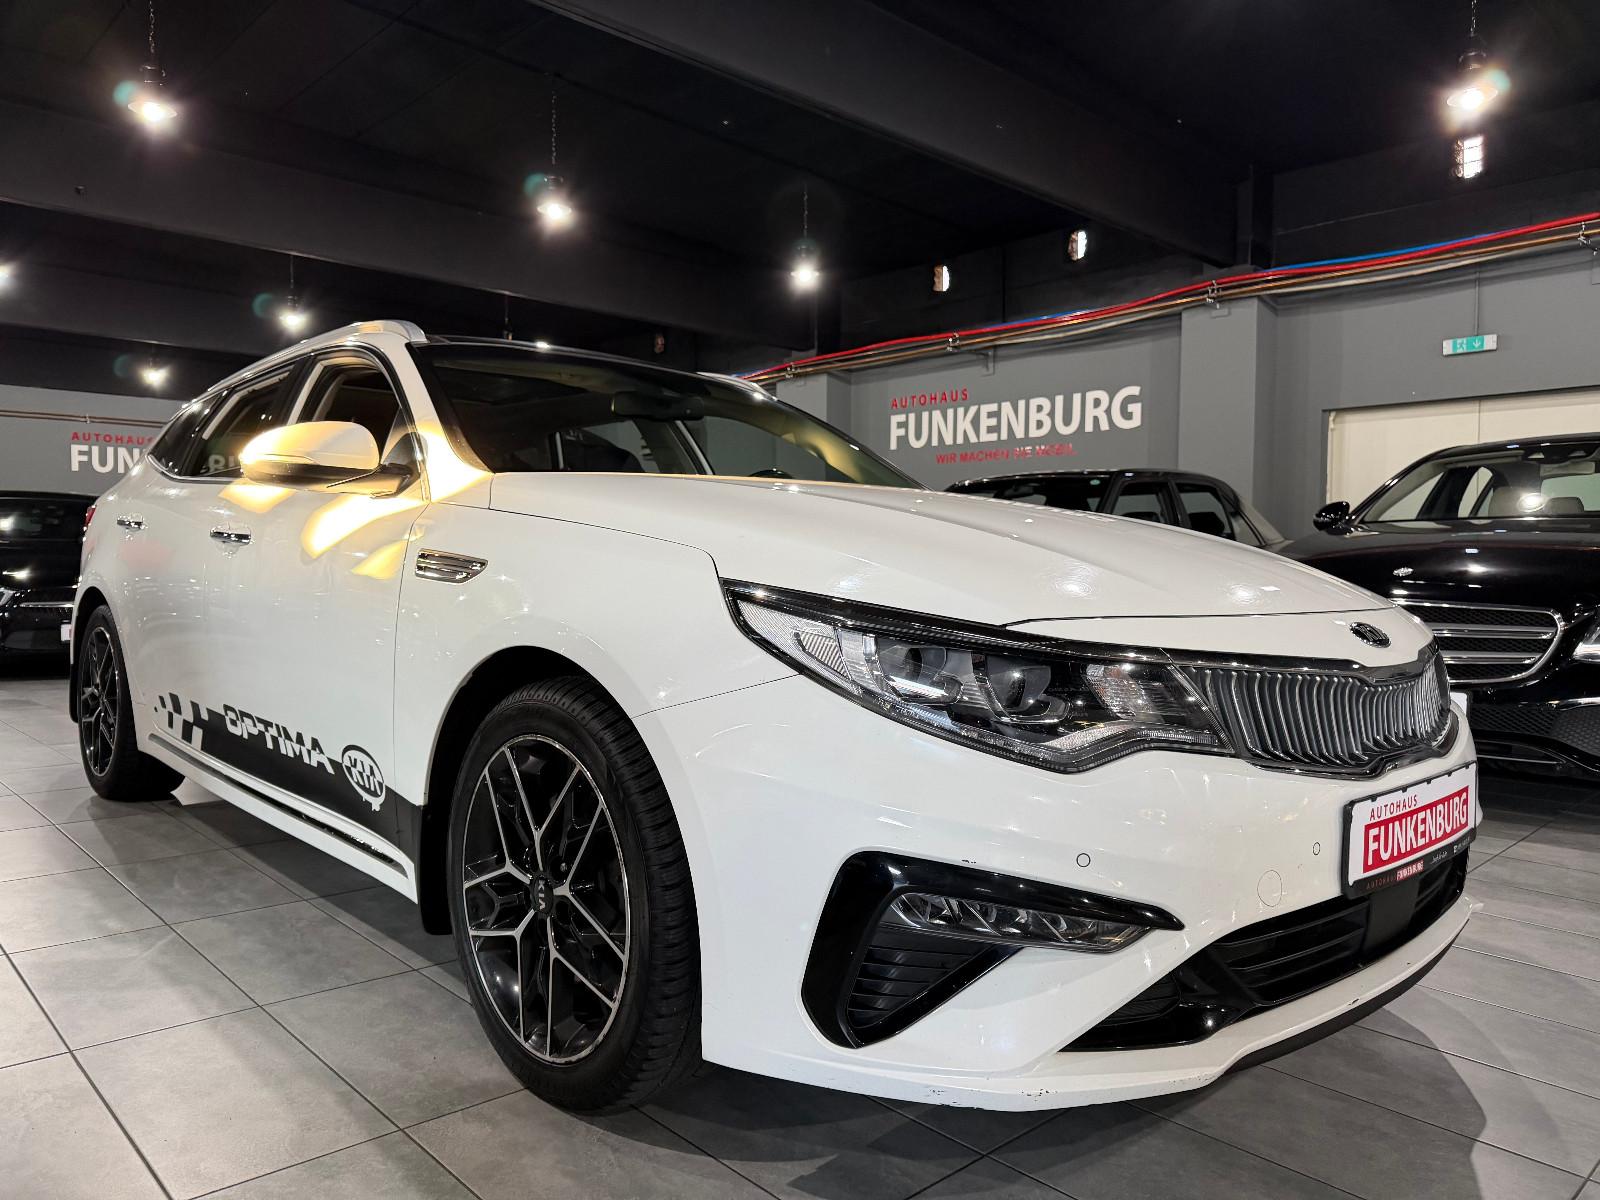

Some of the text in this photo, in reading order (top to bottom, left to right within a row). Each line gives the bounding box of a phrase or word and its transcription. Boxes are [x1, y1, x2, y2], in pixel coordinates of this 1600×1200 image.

[889, 385, 1142, 450] FUNKENBURG
[891, 388, 969, 409] AUTOHAUS
[936, 452, 957, 464] WIR
[960, 449, 1009, 462] MACHEN
[222, 703, 335, 775] OPTIMA
[1367, 791, 1467, 866] FUNKENBURG
[1369, 794, 1418, 822] AUTOHAUS
